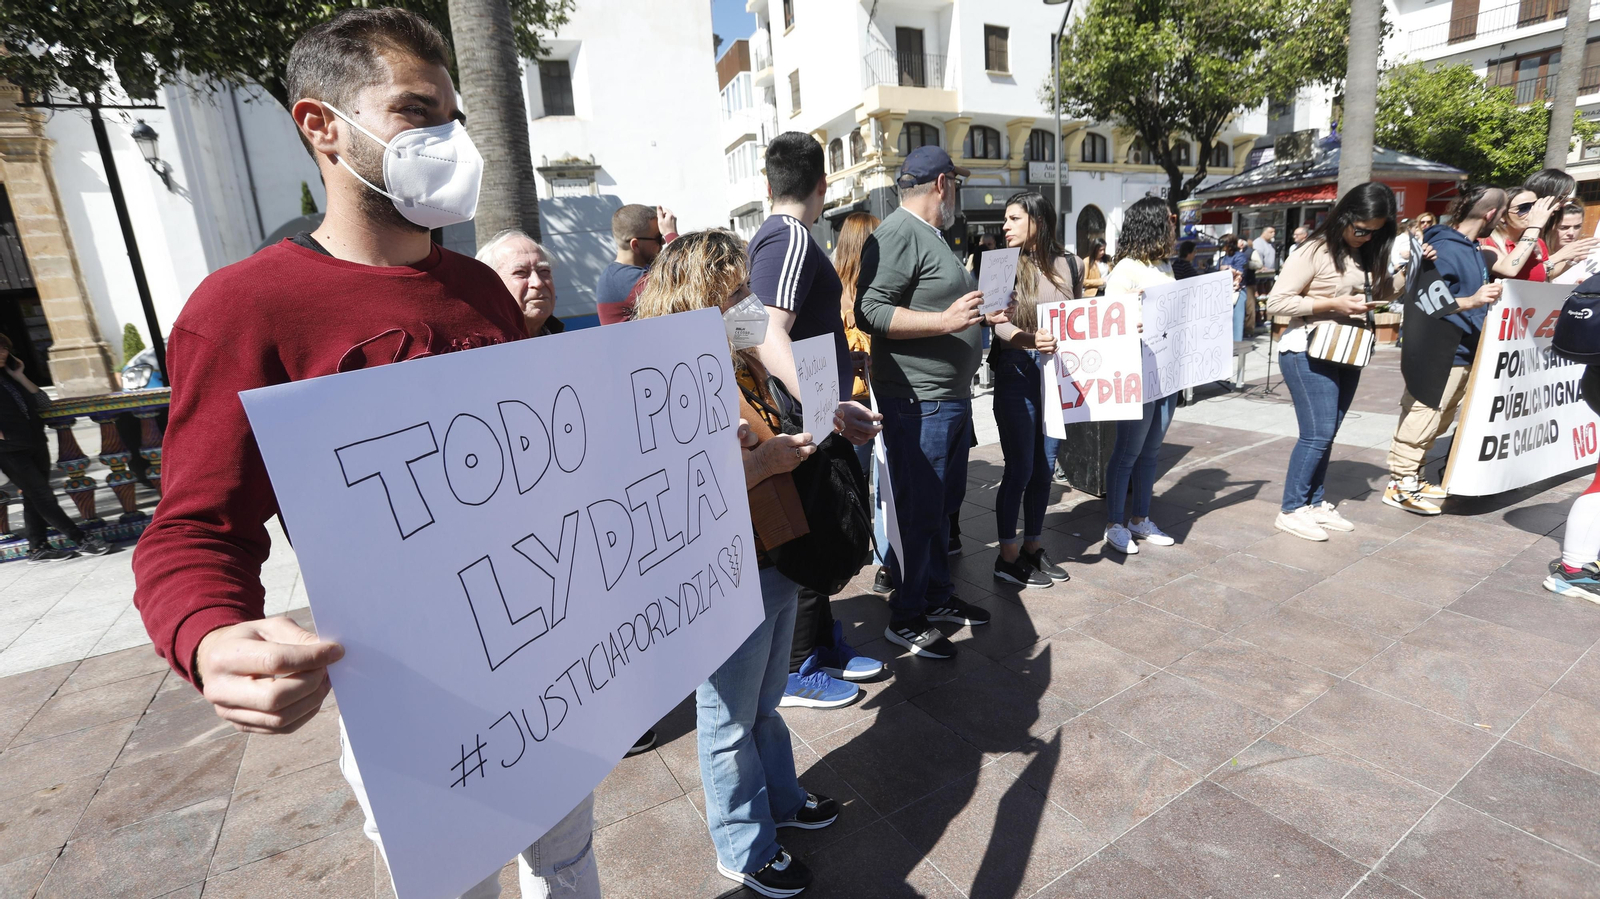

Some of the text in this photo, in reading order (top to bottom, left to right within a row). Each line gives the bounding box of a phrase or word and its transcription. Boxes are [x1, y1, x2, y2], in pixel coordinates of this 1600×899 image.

[1156, 278, 1231, 332] SIEMPRE
[1172, 324, 1198, 359] CON
[1494, 349, 1526, 379] POR
[1058, 371, 1142, 410] LYDIA
[1147, 346, 1223, 399] NOSOTROS
[1489, 379, 1585, 422] PÚBLICA DIGNA
[334, 353, 730, 540] TODO POR
[1478, 419, 1597, 461] DE CALIDAD NO
[457, 450, 728, 672] LYDIA
[450, 563, 725, 788] #JUSTICIAPORLYDIA
